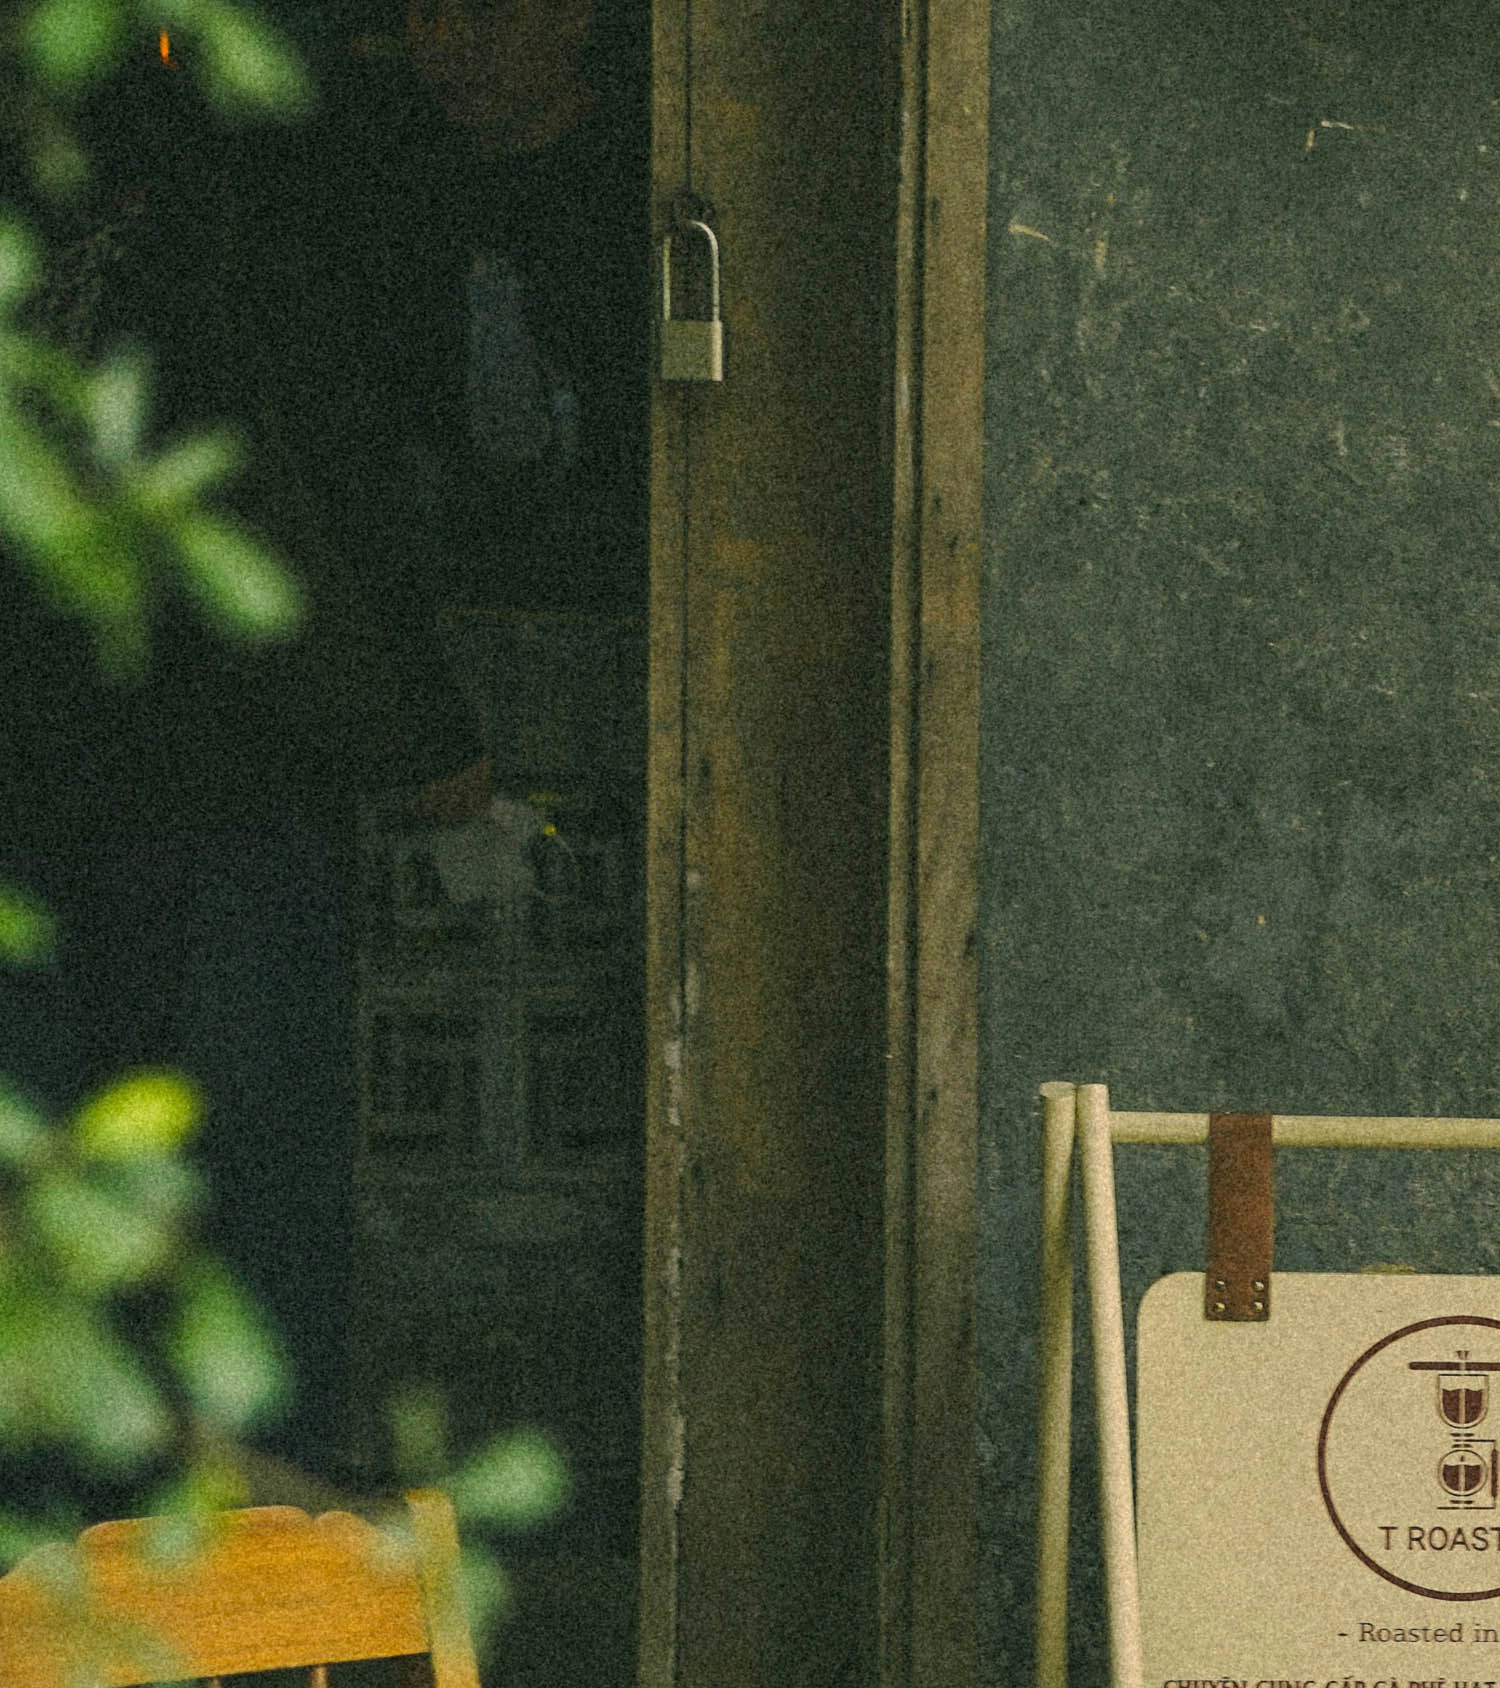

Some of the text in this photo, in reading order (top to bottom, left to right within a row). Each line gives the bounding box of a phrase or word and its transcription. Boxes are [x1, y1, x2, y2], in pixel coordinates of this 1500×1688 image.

[1378, 1526, 1398, 1550] T
[1359, 1622, 1464, 1643] Roasted
[1475, 1624, 1499, 1643] in
